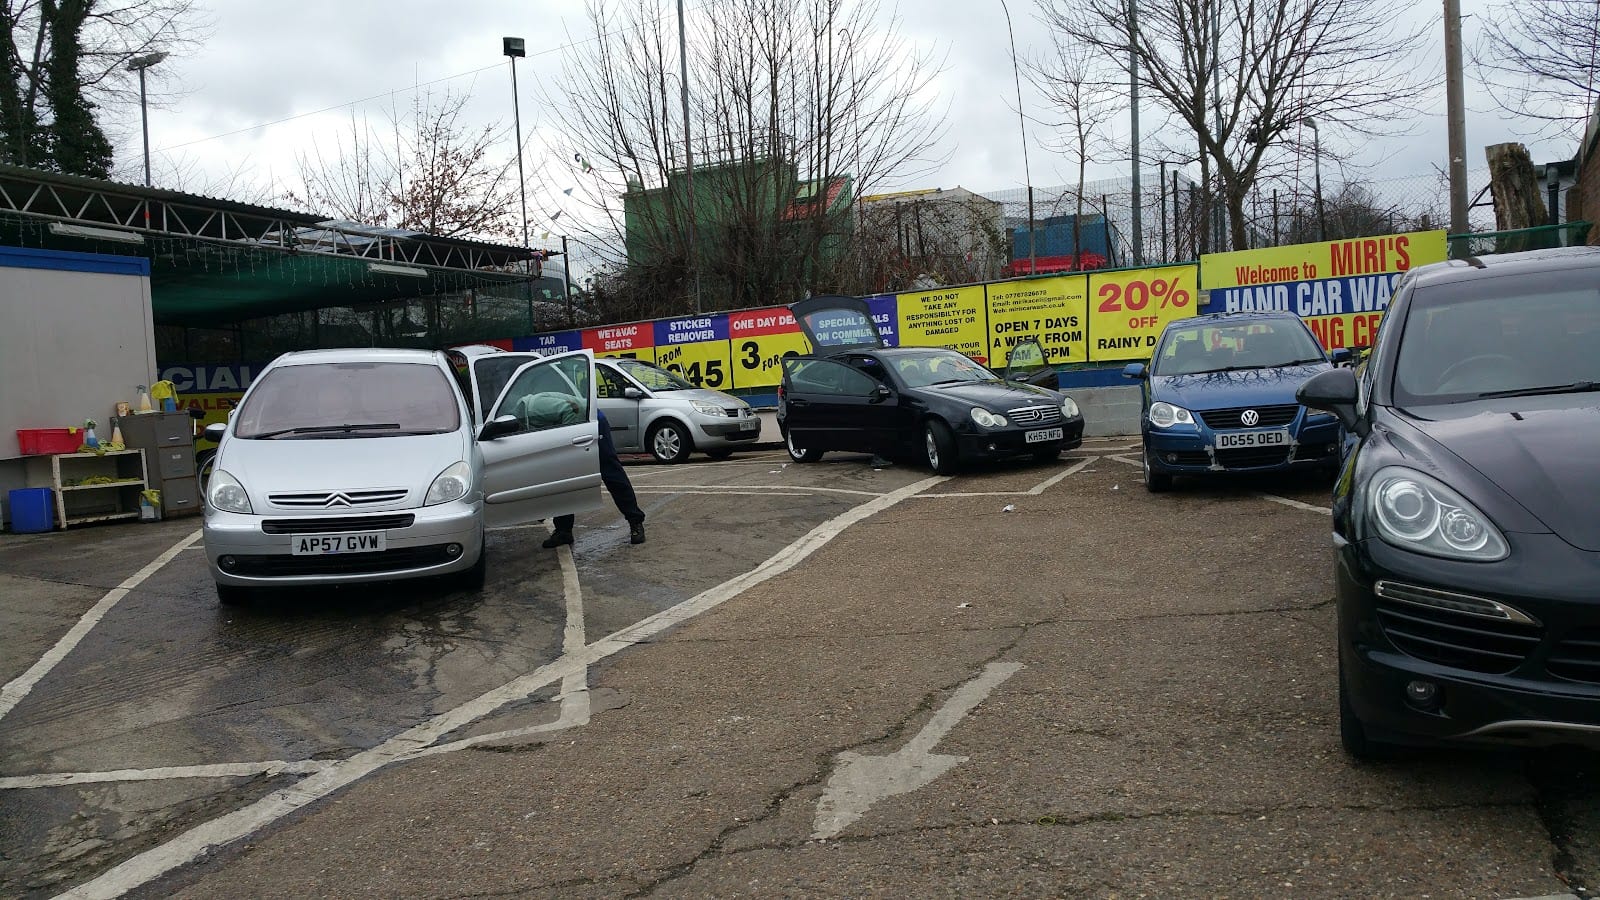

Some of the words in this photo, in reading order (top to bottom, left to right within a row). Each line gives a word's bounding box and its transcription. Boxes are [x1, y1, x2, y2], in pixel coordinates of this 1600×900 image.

[1236, 266, 1299, 286] Welcome
[1302, 261, 1317, 279] to
[1330, 235, 1411, 277] MIRI'S
[1097, 277, 1190, 313] 20%
[1225, 285, 1289, 314] HAND
[1296, 279, 1343, 317] CAR
[670, 318, 712, 332] STICKER
[733, 319, 755, 331] ONE
[757, 316, 777, 328] DAY
[779, 314, 797, 326] DEA
[818, 317, 857, 329] SPECIAL
[859, 313, 890, 324] DALS
[908, 320, 943, 329] ANYTHING
[944, 318, 962, 326] LOST
[995, 321, 1029, 334] OPEN
[1033, 320, 1041, 330] 7
[1045, 316, 1079, 329] DAYS
[1128, 316, 1158, 329] OFF
[597, 326, 638, 340] WET&VAC
[668, 330, 715, 344] REMOVER
[816, 332, 830, 341] ON
[831, 326, 894, 340] COMMERIAL
[925, 327, 959, 336] DAMAGED
[539, 336, 556, 346] TAR
[604, 338, 633, 350] SEATS
[960, 341, 980, 349] YOUR
[993, 337, 1002, 348] A
[1044, 331, 1082, 344] FROM
[1097, 336, 1142, 350] RAINY
[658, 346, 682, 366] FROM
[741, 341, 761, 370] 3
[762, 354, 780, 371] FOR
[1043, 346, 1070, 359] 6PM
[158, 366, 252, 391] CIAL
[1028, 431, 1048, 442] KH53
[1221, 434, 1255, 447] DG55
[1257, 432, 1283, 444] OED
[299, 537, 342, 553] AP57
[347, 534, 379, 550] GVW
